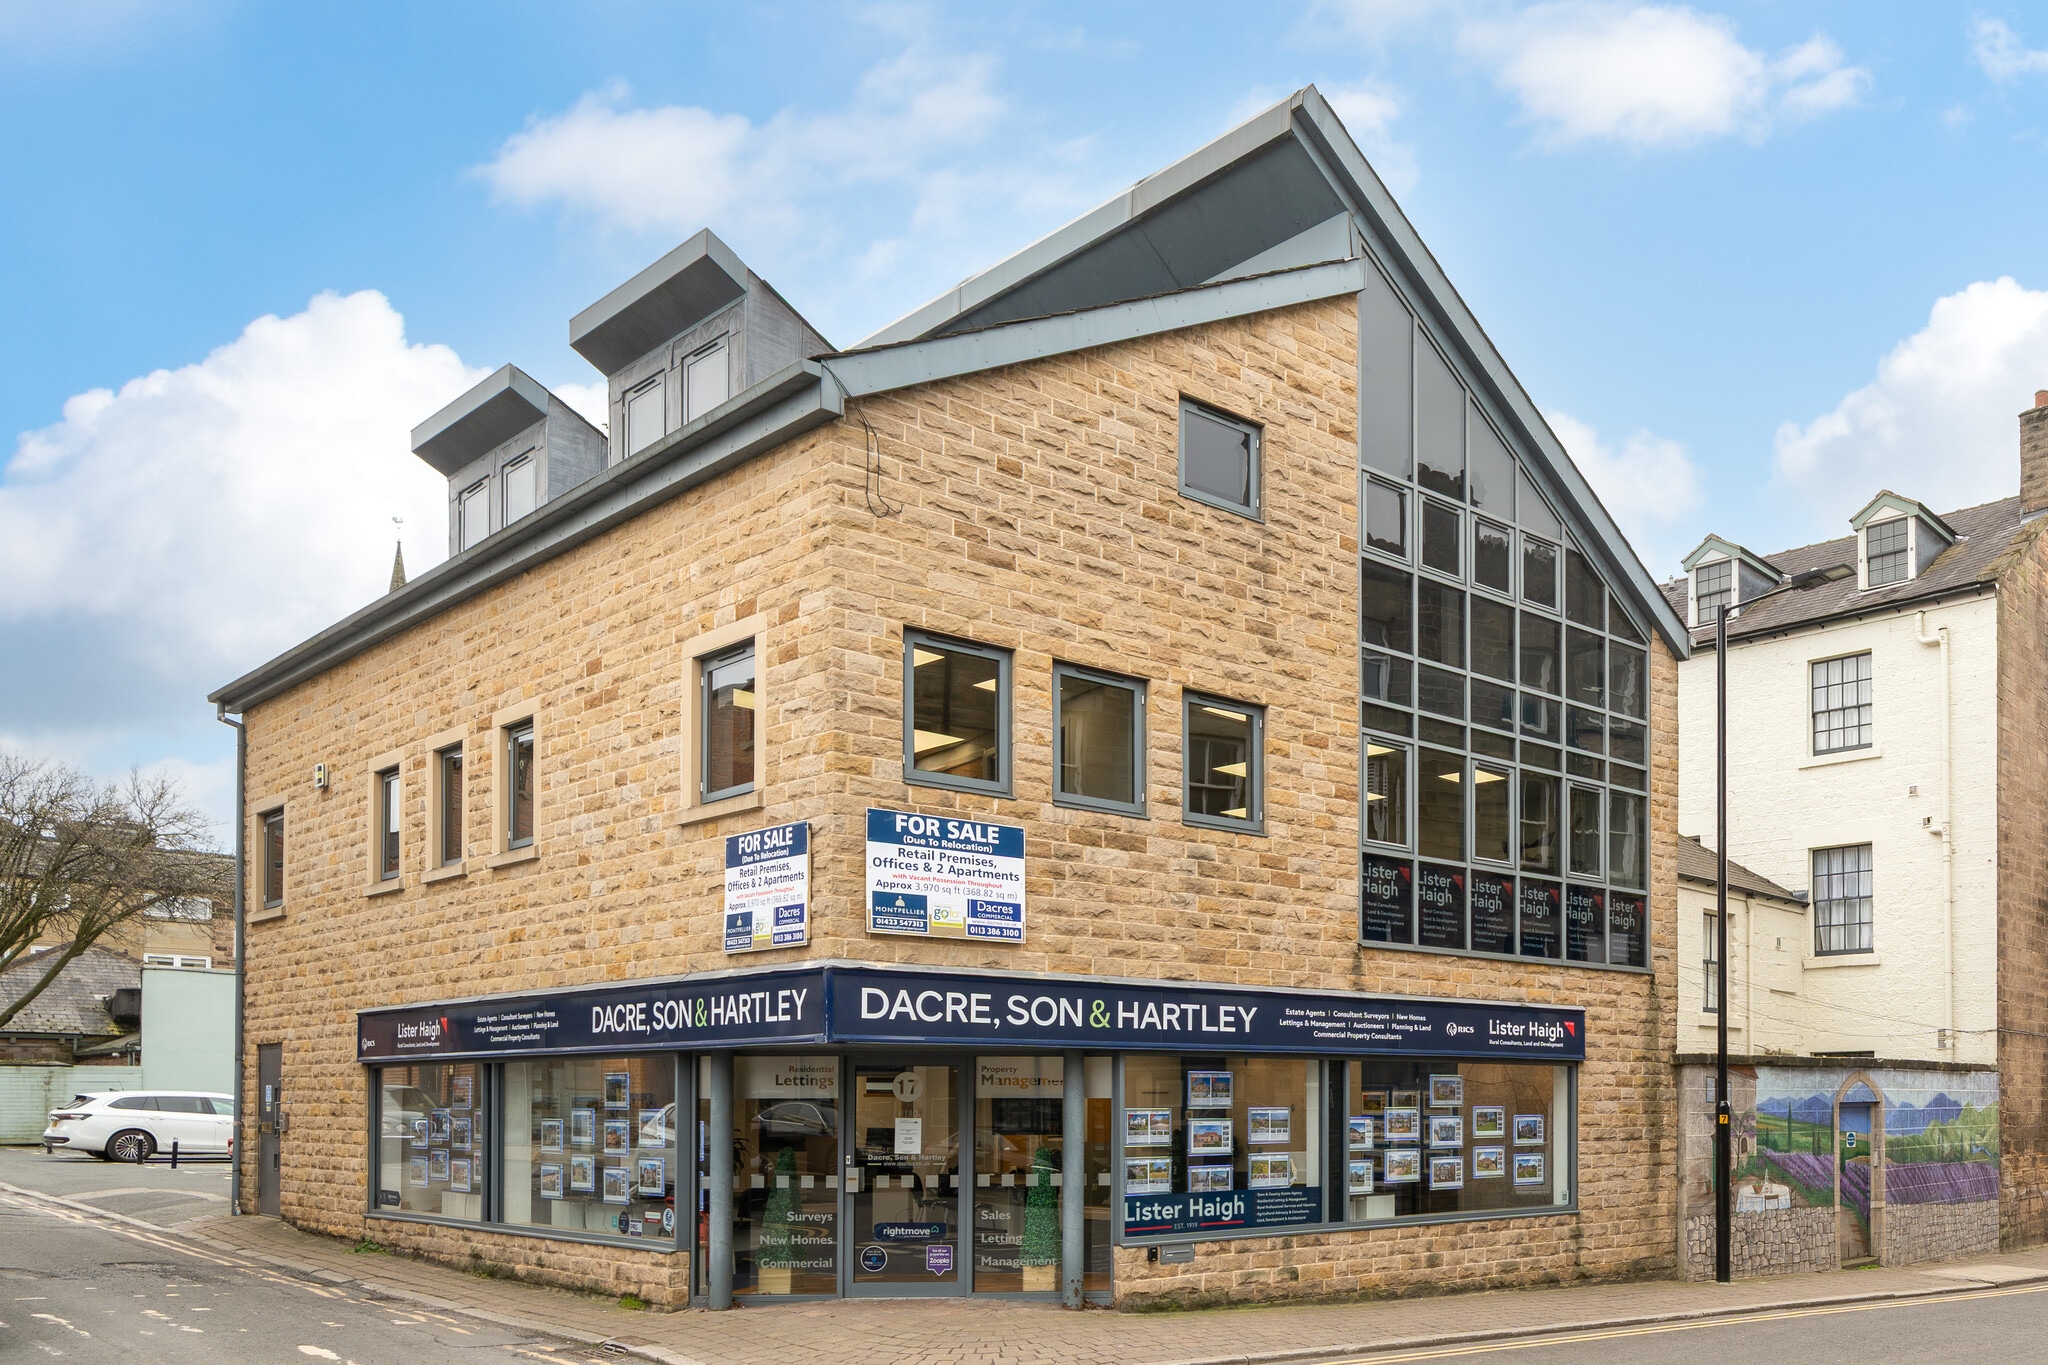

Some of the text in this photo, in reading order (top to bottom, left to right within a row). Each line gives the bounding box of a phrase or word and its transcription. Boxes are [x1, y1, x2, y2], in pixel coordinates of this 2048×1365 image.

[895, 814, 1000, 844] FOR SALE
[738, 827, 793, 854] FOR SALE
[903, 835, 926, 845] (Due
[942, 840, 993, 853] Relocation)
[742, 848, 789, 864] (Due To Relocation)
[898, 848, 997, 869] Retail Premises,
[739, 862, 792, 878] Retail Premises,
[873, 857, 1020, 881] Offices & 2 Apartments
[1363, 863, 1398, 880] Lister
[728, 871, 804, 892] Offices & 2 Apartments
[933, 877, 966, 885] Possession
[967, 880, 1002, 889] Throughout
[1419, 871, 1451, 888] Lister
[876, 880, 1018, 900] Approx 3,970 sq ft (368.82 sq m)
[1363, 879, 1398, 899] Haigh
[1419, 886, 1452, 906] Haigh
[729, 900, 746, 912] Approx
[747, 899, 759, 908] 3,970
[771, 895, 789, 905] (368.82
[876, 906, 925, 915] MONTPELLIER
[977, 901, 1013, 914] Dacres
[1471, 894, 1502, 913] Haigh
[1520, 900, 1549, 918] Haigh
[779, 908, 800, 918] Dacres
[977, 913, 1013, 921] COMMERCIAL
[1566, 906, 1593, 924] Haigh
[1610, 912, 1635, 929] Haigh
[727, 926, 751, 934] MONTPELLIER
[900, 919, 924, 927] 547313
[774, 934, 783, 942] 0113
[784, 933, 792, 941] 386
[517, 1013, 532, 1021] Surveyors
[592, 988, 808, 1035] DACRE, SON & HARTLEY
[861, 987, 1258, 1033] DACRE, SON & HARTLEY
[1363, 1012, 1389, 1020] Surveyors
[398, 1018, 440, 1040] Lister Haigh
[489, 1024, 508, 1032] Management
[533, 1022, 547, 1030] Planning
[1280, 1019, 1303, 1027] Lettings
[1458, 1025, 1474, 1033] RICS
[1489, 1019, 1564, 1042] Lister Haigh
[1347, 1032, 1370, 1040] Property
[981, 1066, 1017, 1074] Property
[775, 1074, 834, 1089] Lettings
[897, 1080, 918, 1094] 17
[981, 1210, 1011, 1220] Sales
[1125, 1194, 1245, 1222] Lister Haigh
[787, 1212, 833, 1223] Surveys
[883, 1227, 930, 1236] rightmove
[760, 1235, 833, 1245] New Homes
[760, 1258, 833, 1268] Commercial
[981, 1257, 1057, 1268] Management
